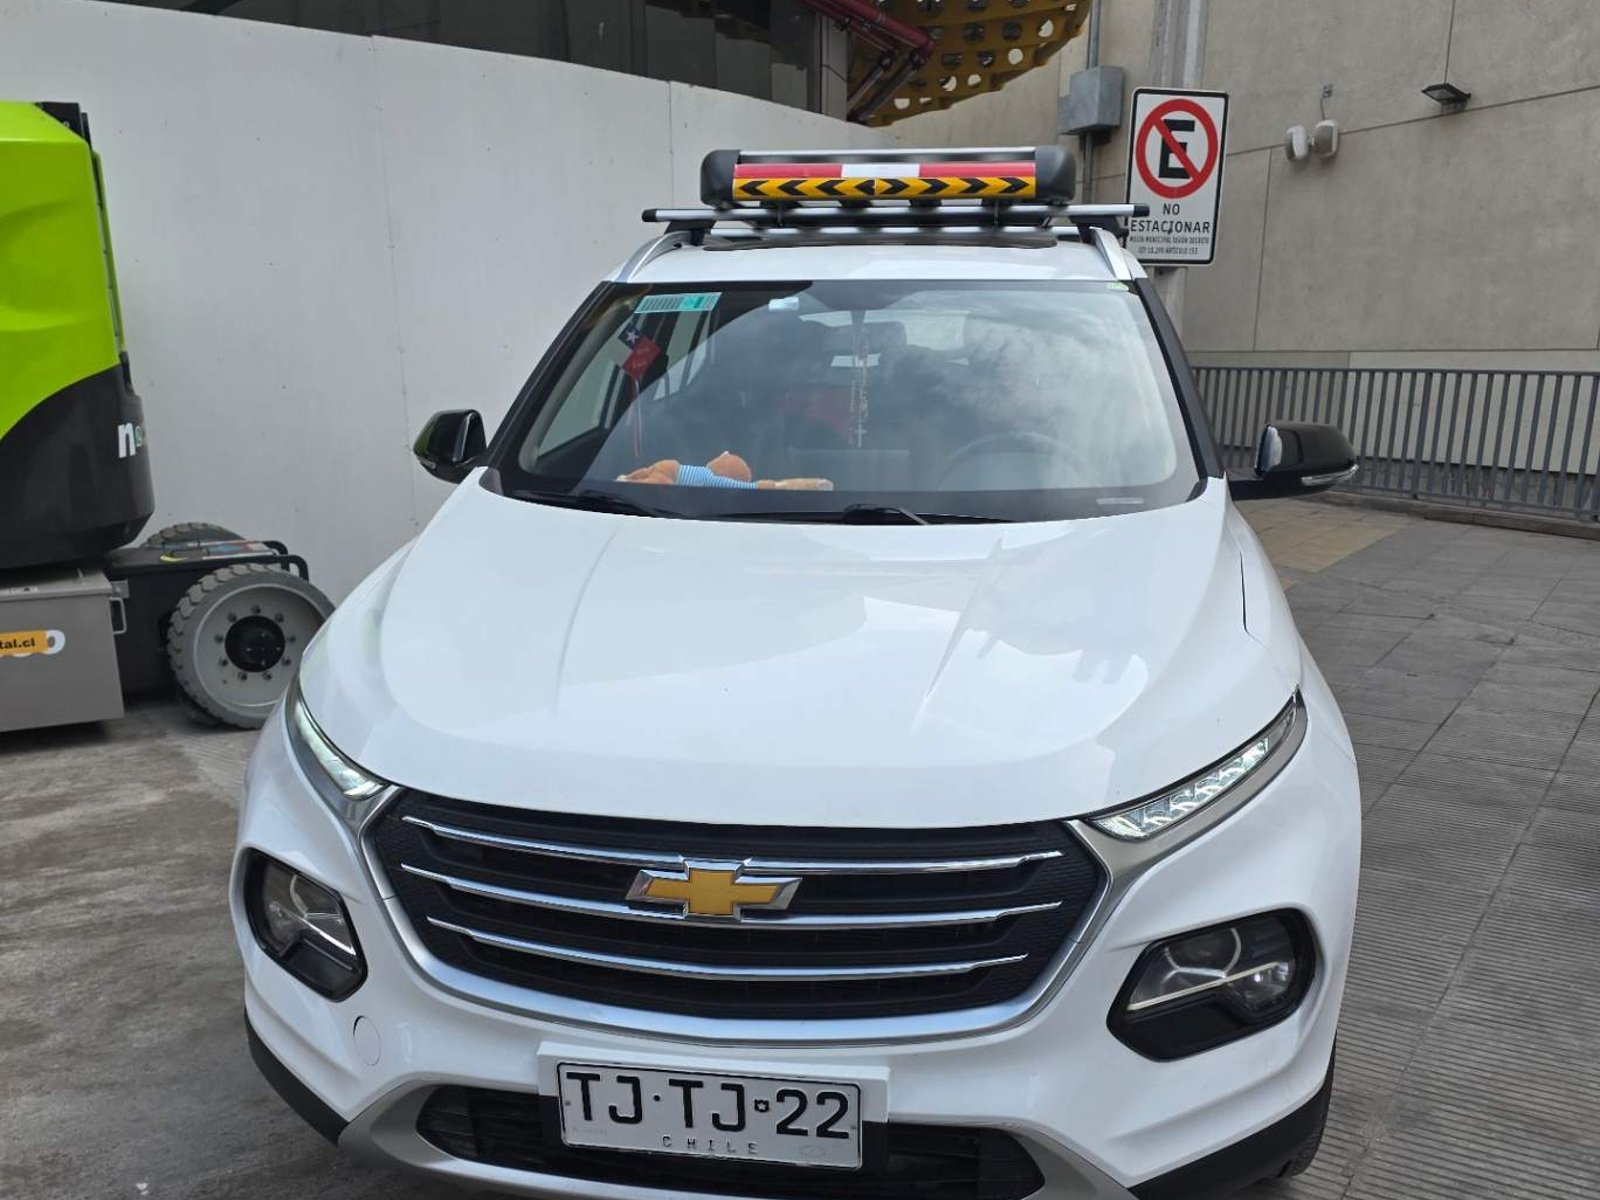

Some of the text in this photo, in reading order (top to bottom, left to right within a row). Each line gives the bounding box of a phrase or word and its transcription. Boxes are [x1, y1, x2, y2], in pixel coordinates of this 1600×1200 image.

[1163, 203, 1180, 216] NO
[1130, 219, 1211, 234] ESTACIONAR
[662, 1135, 758, 1155] CHILE
